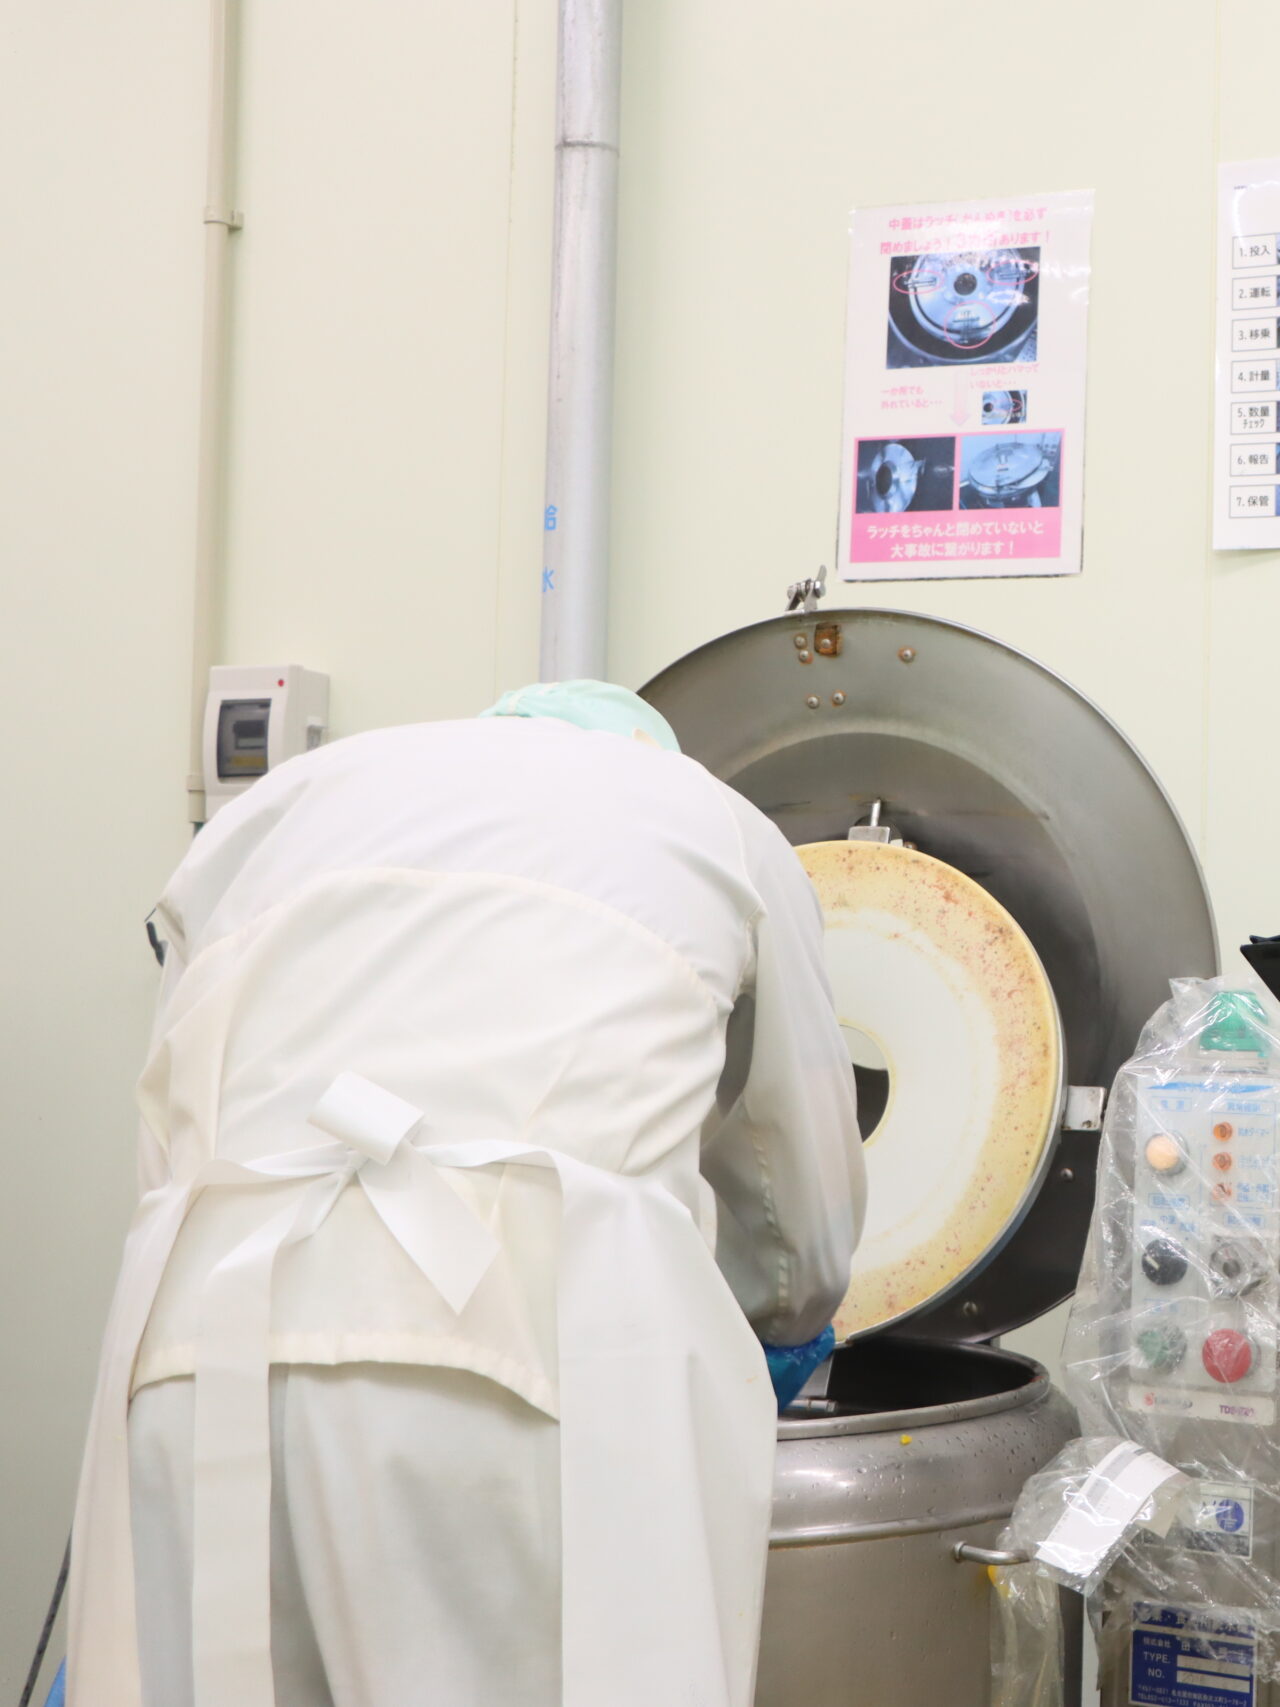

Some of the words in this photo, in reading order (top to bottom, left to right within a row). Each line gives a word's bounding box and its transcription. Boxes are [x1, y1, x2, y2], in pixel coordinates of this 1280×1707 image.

[867, 520, 1045, 540] ラッチをちゃんと閉めていないと
[890, 541, 1015, 559] 大事故に繋がります！
[1147, 1667, 1166, 1680] NO.
